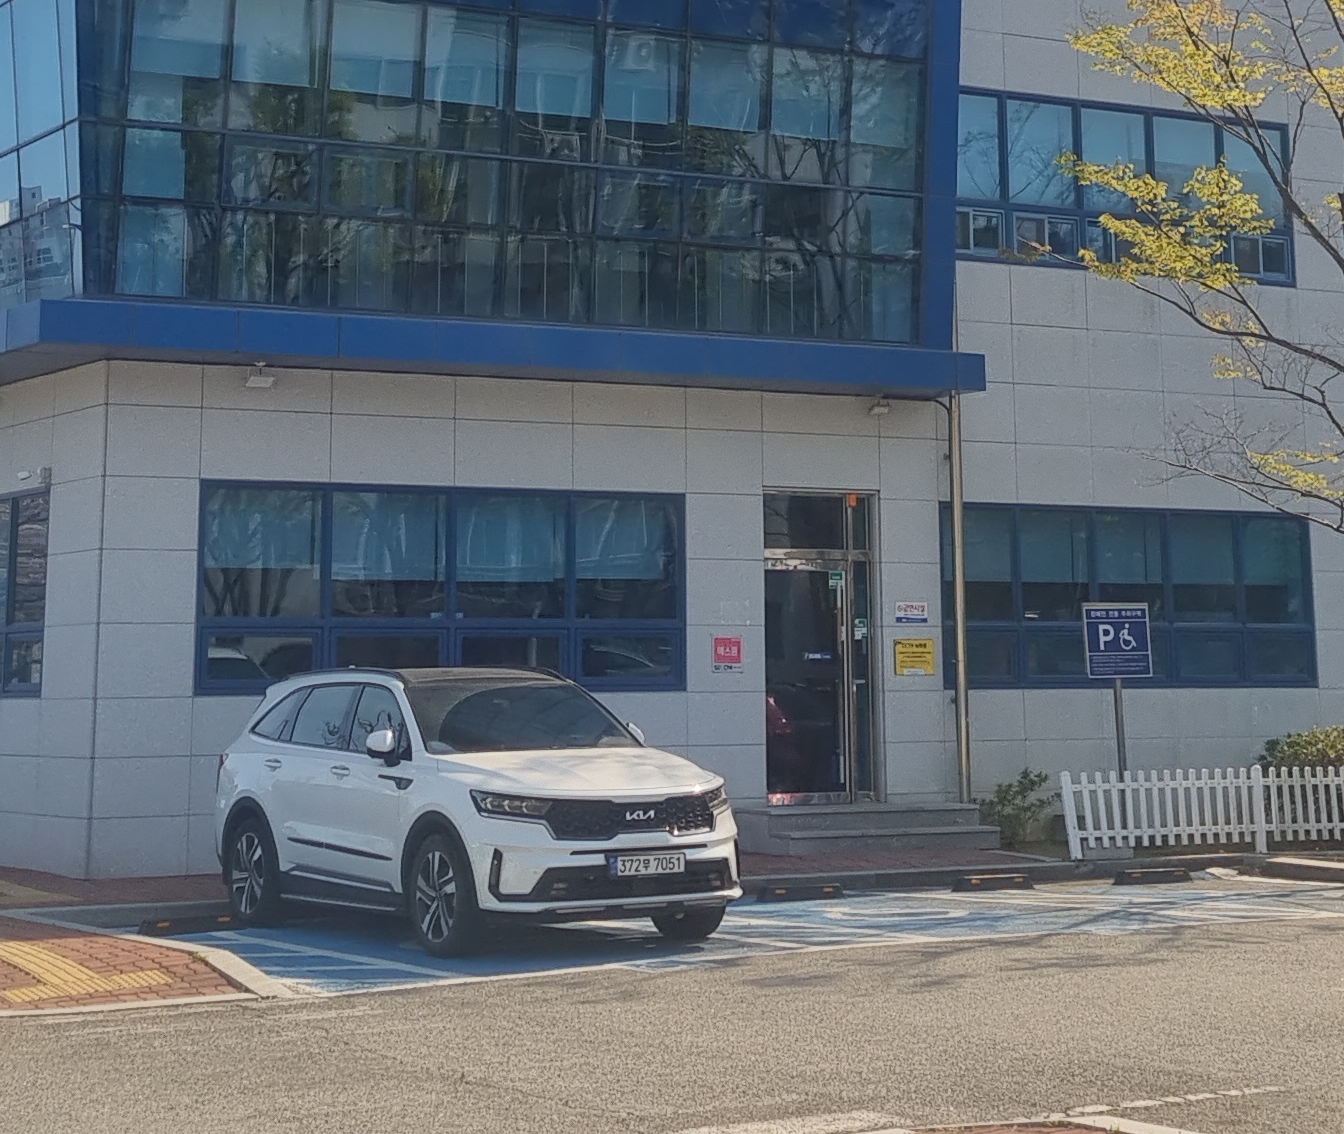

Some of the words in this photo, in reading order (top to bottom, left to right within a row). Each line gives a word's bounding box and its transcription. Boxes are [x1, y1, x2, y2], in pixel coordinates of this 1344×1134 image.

[1098, 624, 1115, 651] P
[619, 858, 651, 874] 372무
[653, 856, 681, 872] 7051
